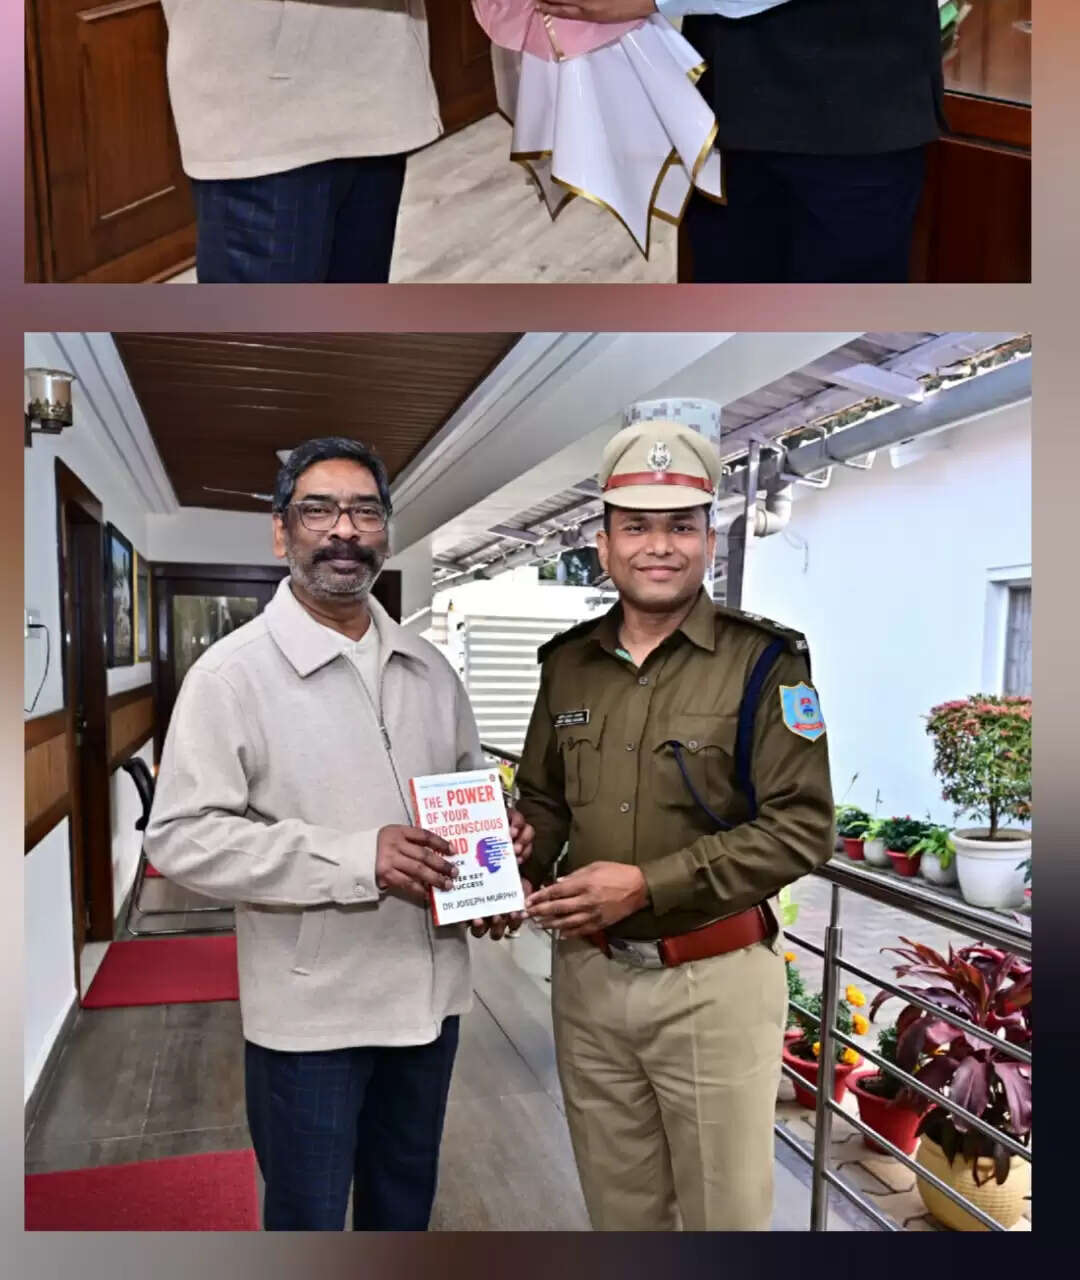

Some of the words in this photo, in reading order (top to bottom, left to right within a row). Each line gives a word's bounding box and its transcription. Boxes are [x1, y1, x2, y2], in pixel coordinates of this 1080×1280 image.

[423, 796, 443, 810] THE
[446, 785, 495, 807] POWER
[426, 812, 439, 825] OF
[441, 808, 470, 823] YOUR
[469, 872, 483, 880] KEY
[442, 901, 454, 911] DR
[456, 897, 486, 909] JOSEPH
[486, 891, 517, 902] MURPHY
